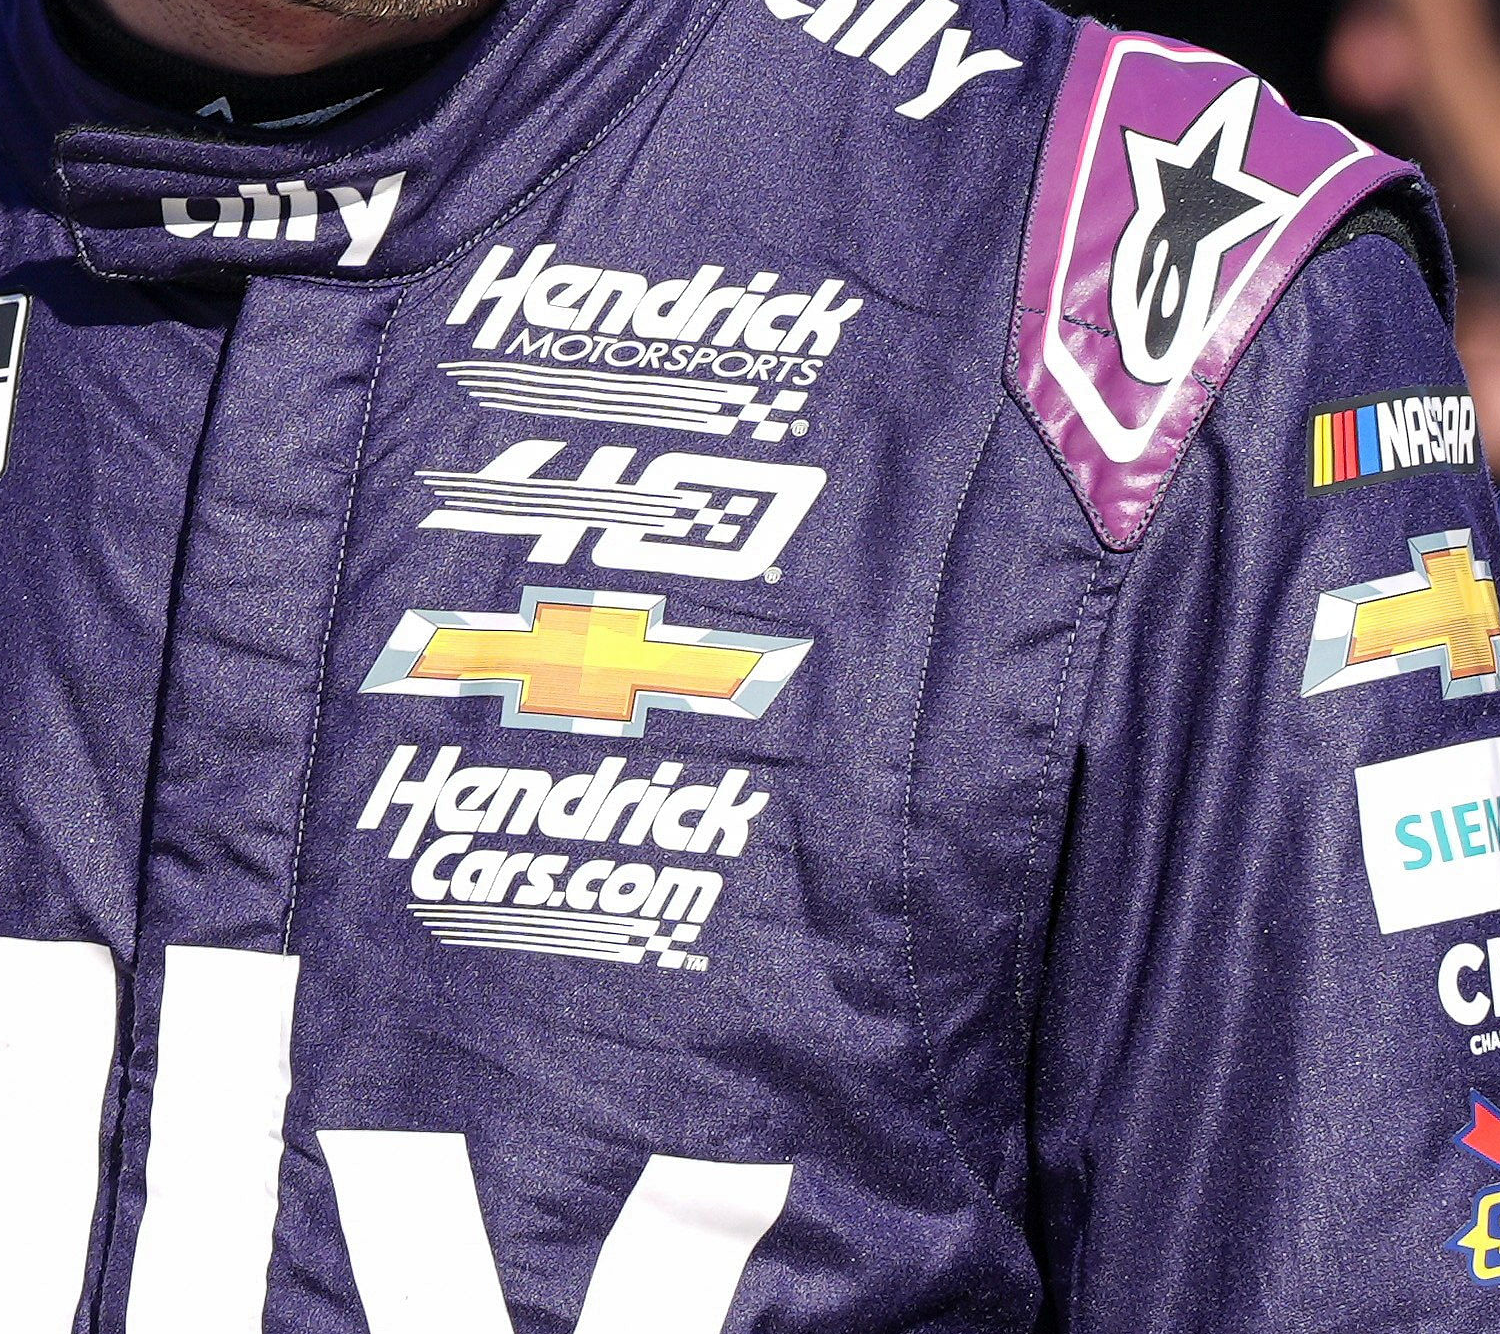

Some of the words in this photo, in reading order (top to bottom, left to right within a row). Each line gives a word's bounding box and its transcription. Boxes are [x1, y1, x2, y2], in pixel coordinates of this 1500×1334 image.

[445, 243, 864, 357] Hendrick
[505, 328, 824, 386] MOTORSPORTS
[356, 744, 770, 859] Hendrick
[410, 833, 724, 923] Cars.com
